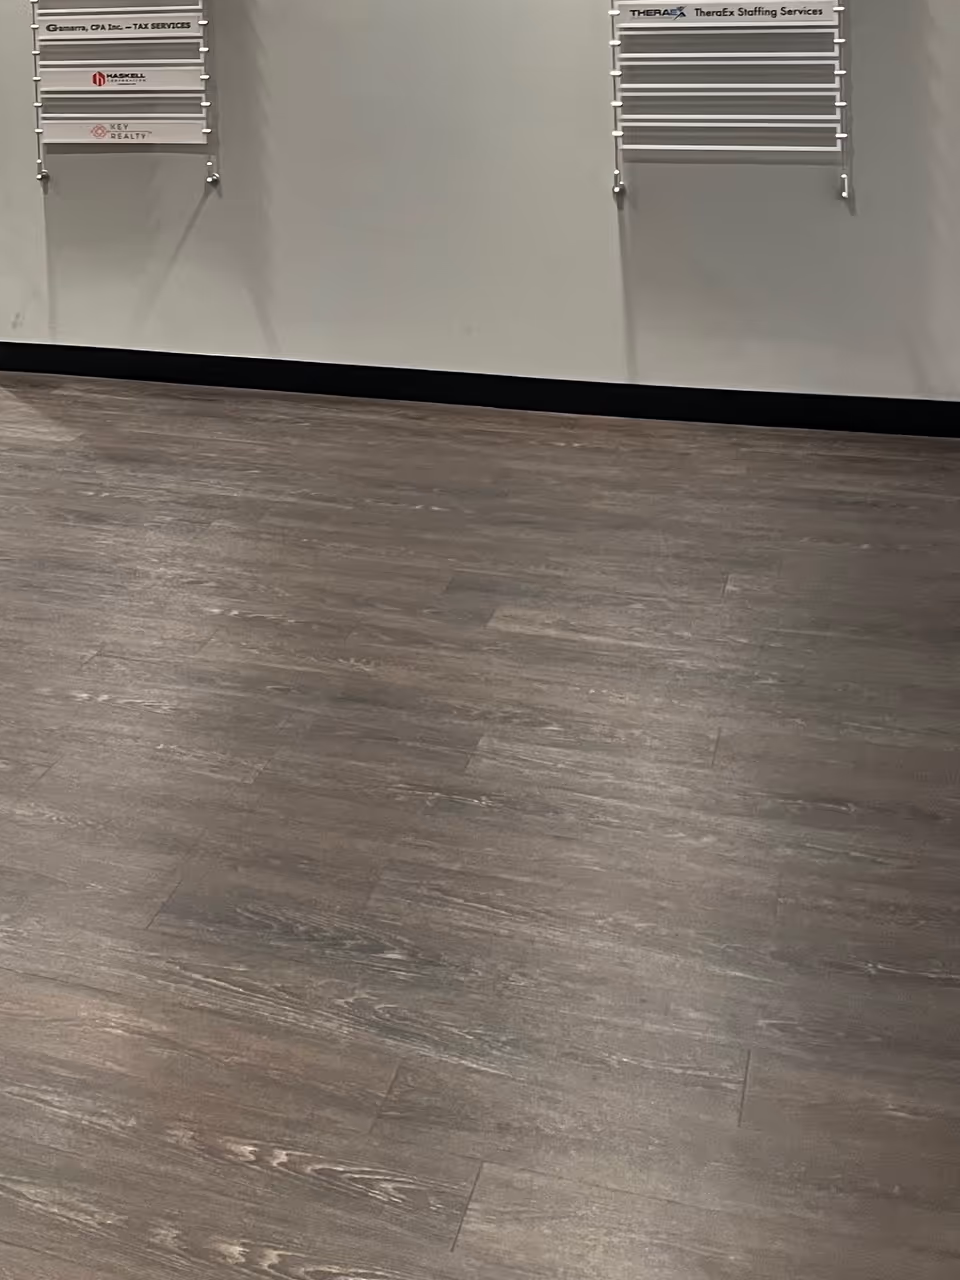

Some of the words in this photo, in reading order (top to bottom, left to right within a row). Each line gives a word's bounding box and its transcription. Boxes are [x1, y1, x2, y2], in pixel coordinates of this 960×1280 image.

[694, 8, 735, 17] TheraEx
[737, 7, 777, 18] Staffing
[780, 7, 823, 16] Services
[151, 22, 191, 30] SERVICES
